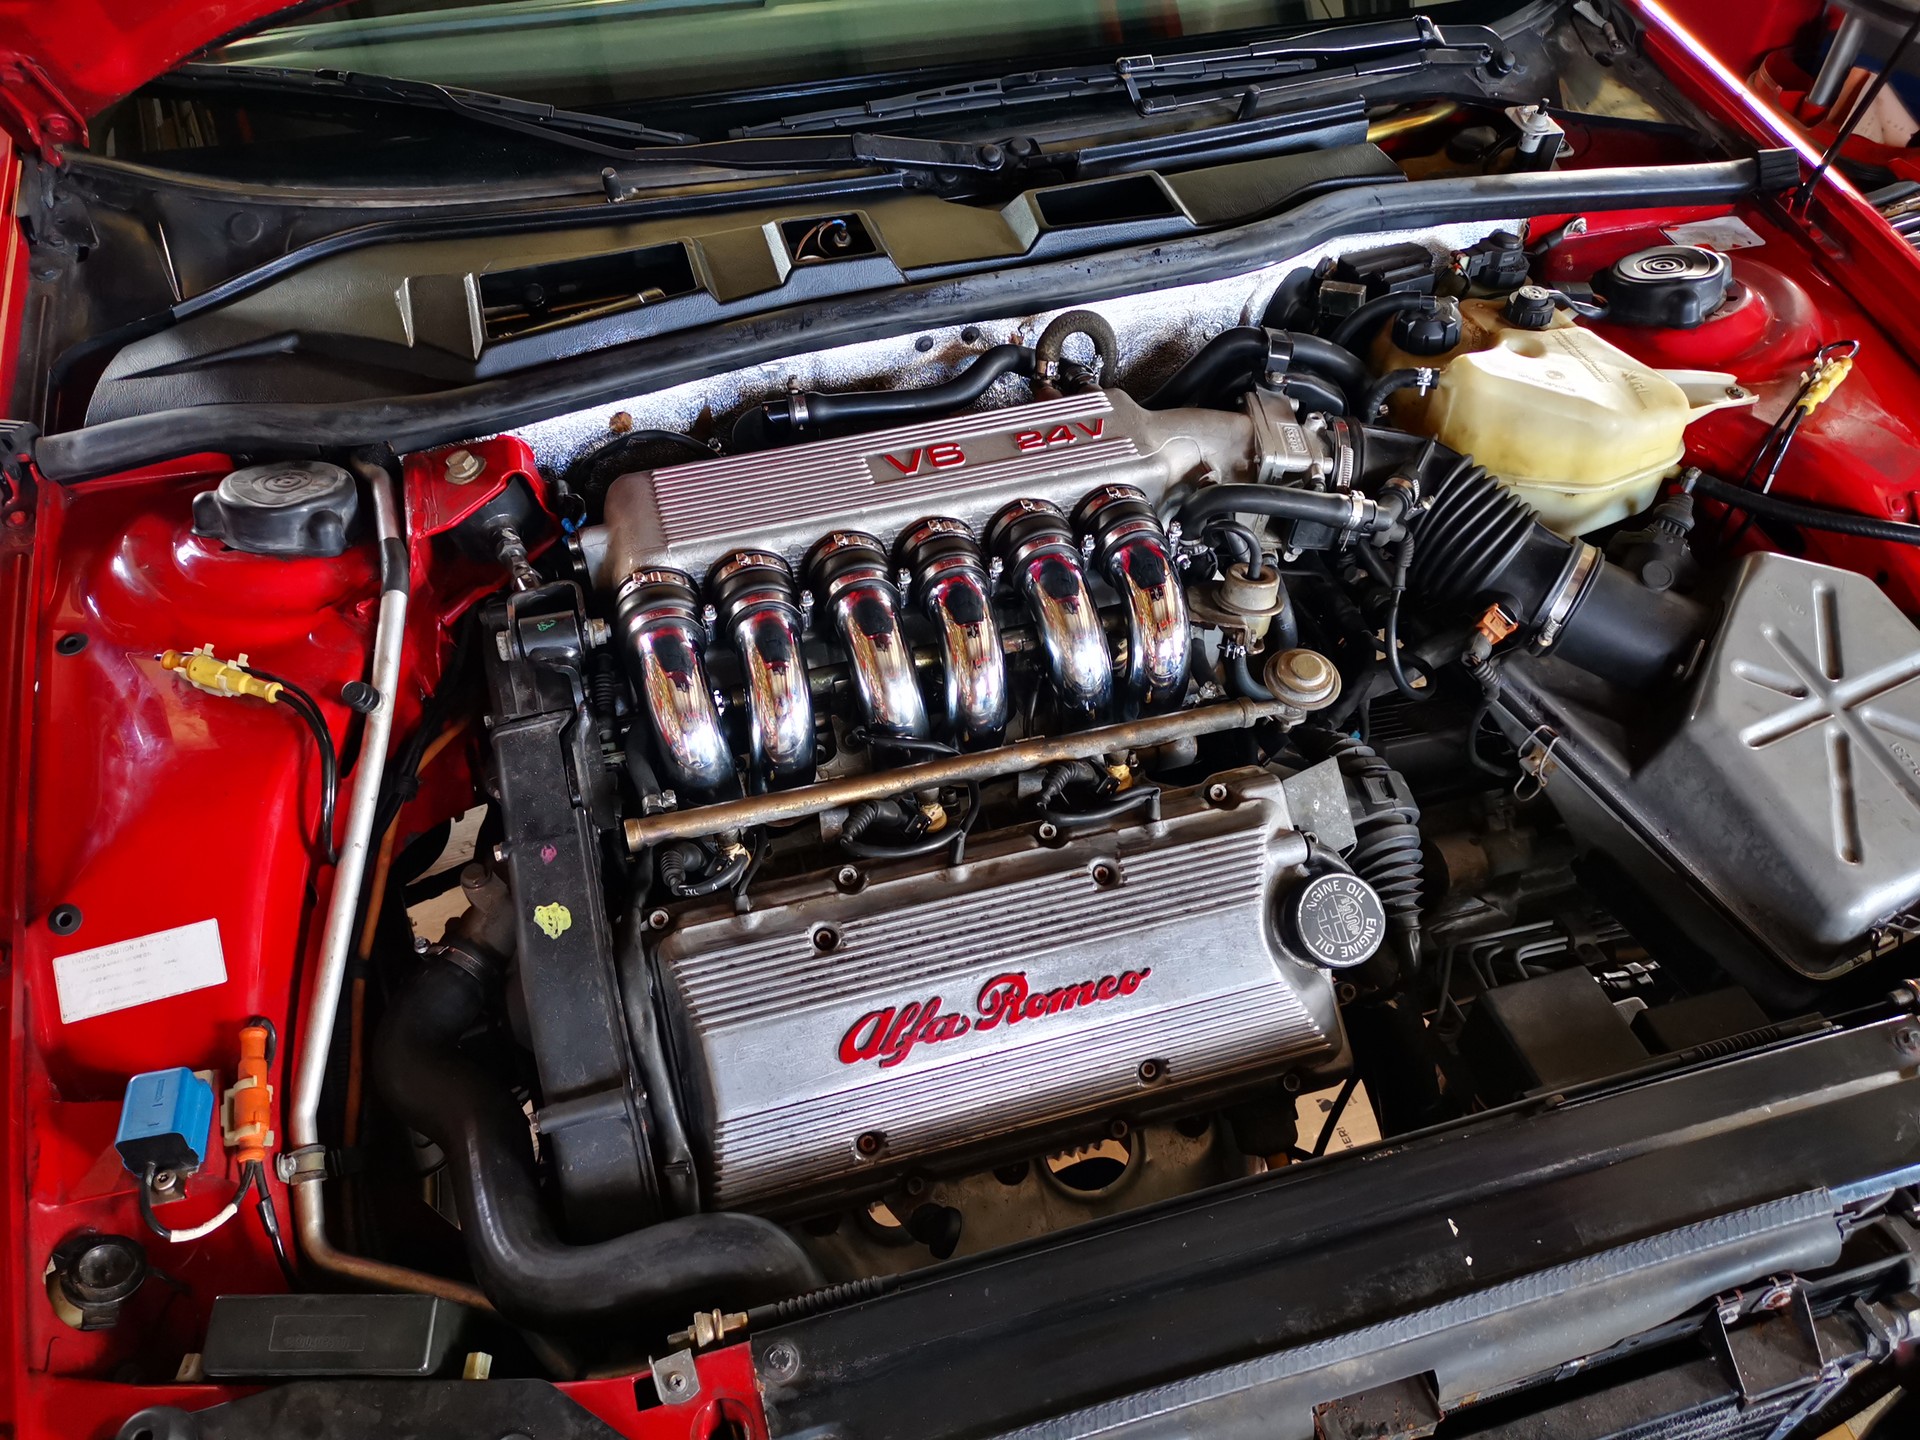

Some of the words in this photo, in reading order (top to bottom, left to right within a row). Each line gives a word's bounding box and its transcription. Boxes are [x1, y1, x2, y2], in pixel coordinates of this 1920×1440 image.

[884, 443, 966, 475] V6
[1015, 418, 1104, 451] 24V
[1305, 880, 1341, 912] NGINE
[1346, 882, 1366, 904] OIL
[1315, 934, 1335, 956] OIL
[1340, 917, 1377, 958] ENGINE
[838, 996, 972, 1068] Alfa
[974, 968, 1151, 1031] Romeo
